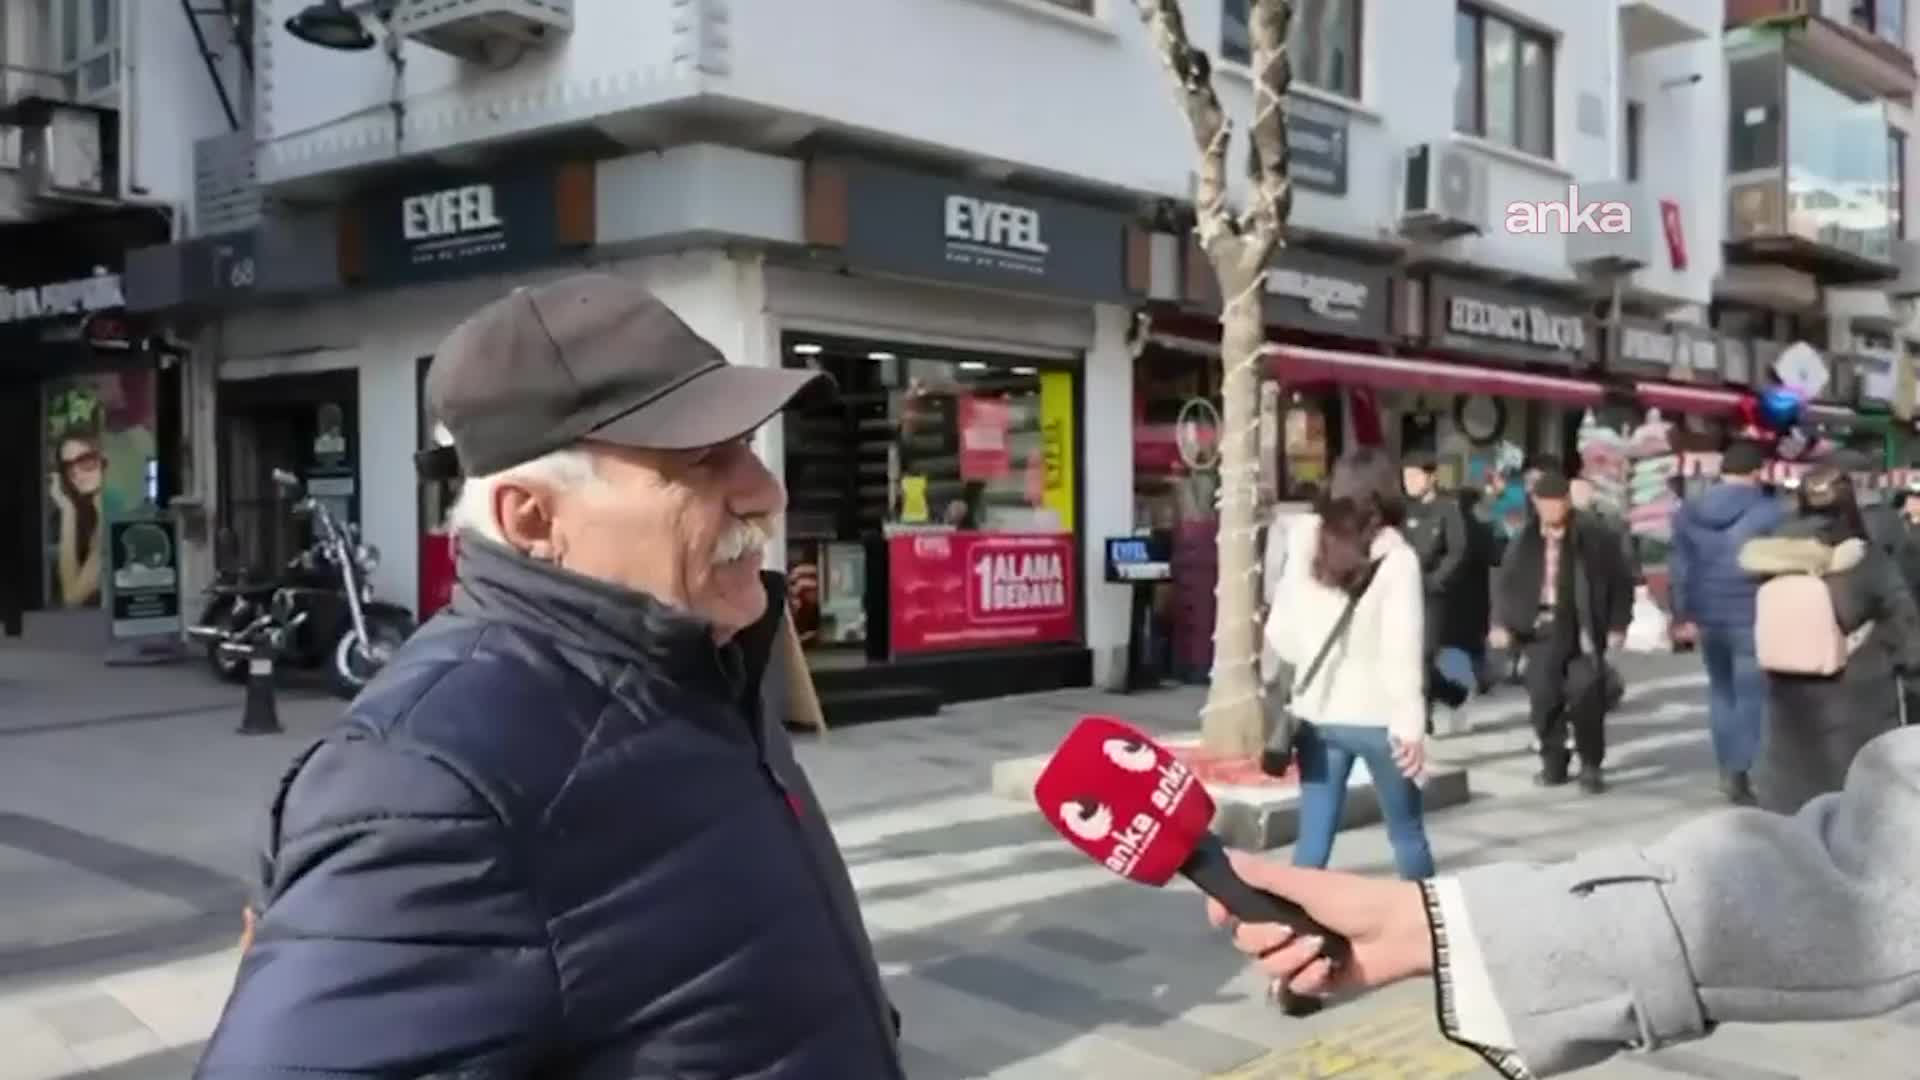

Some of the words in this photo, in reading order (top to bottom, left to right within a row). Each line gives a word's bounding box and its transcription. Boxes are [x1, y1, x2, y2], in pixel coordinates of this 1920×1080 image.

[402, 184, 504, 240] EYFEL
[946, 195, 1048, 252] EYFEL
[974, 555, 992, 612] 1
[992, 553, 1064, 583] ALANA
[1104, 813, 1153, 871] anka
